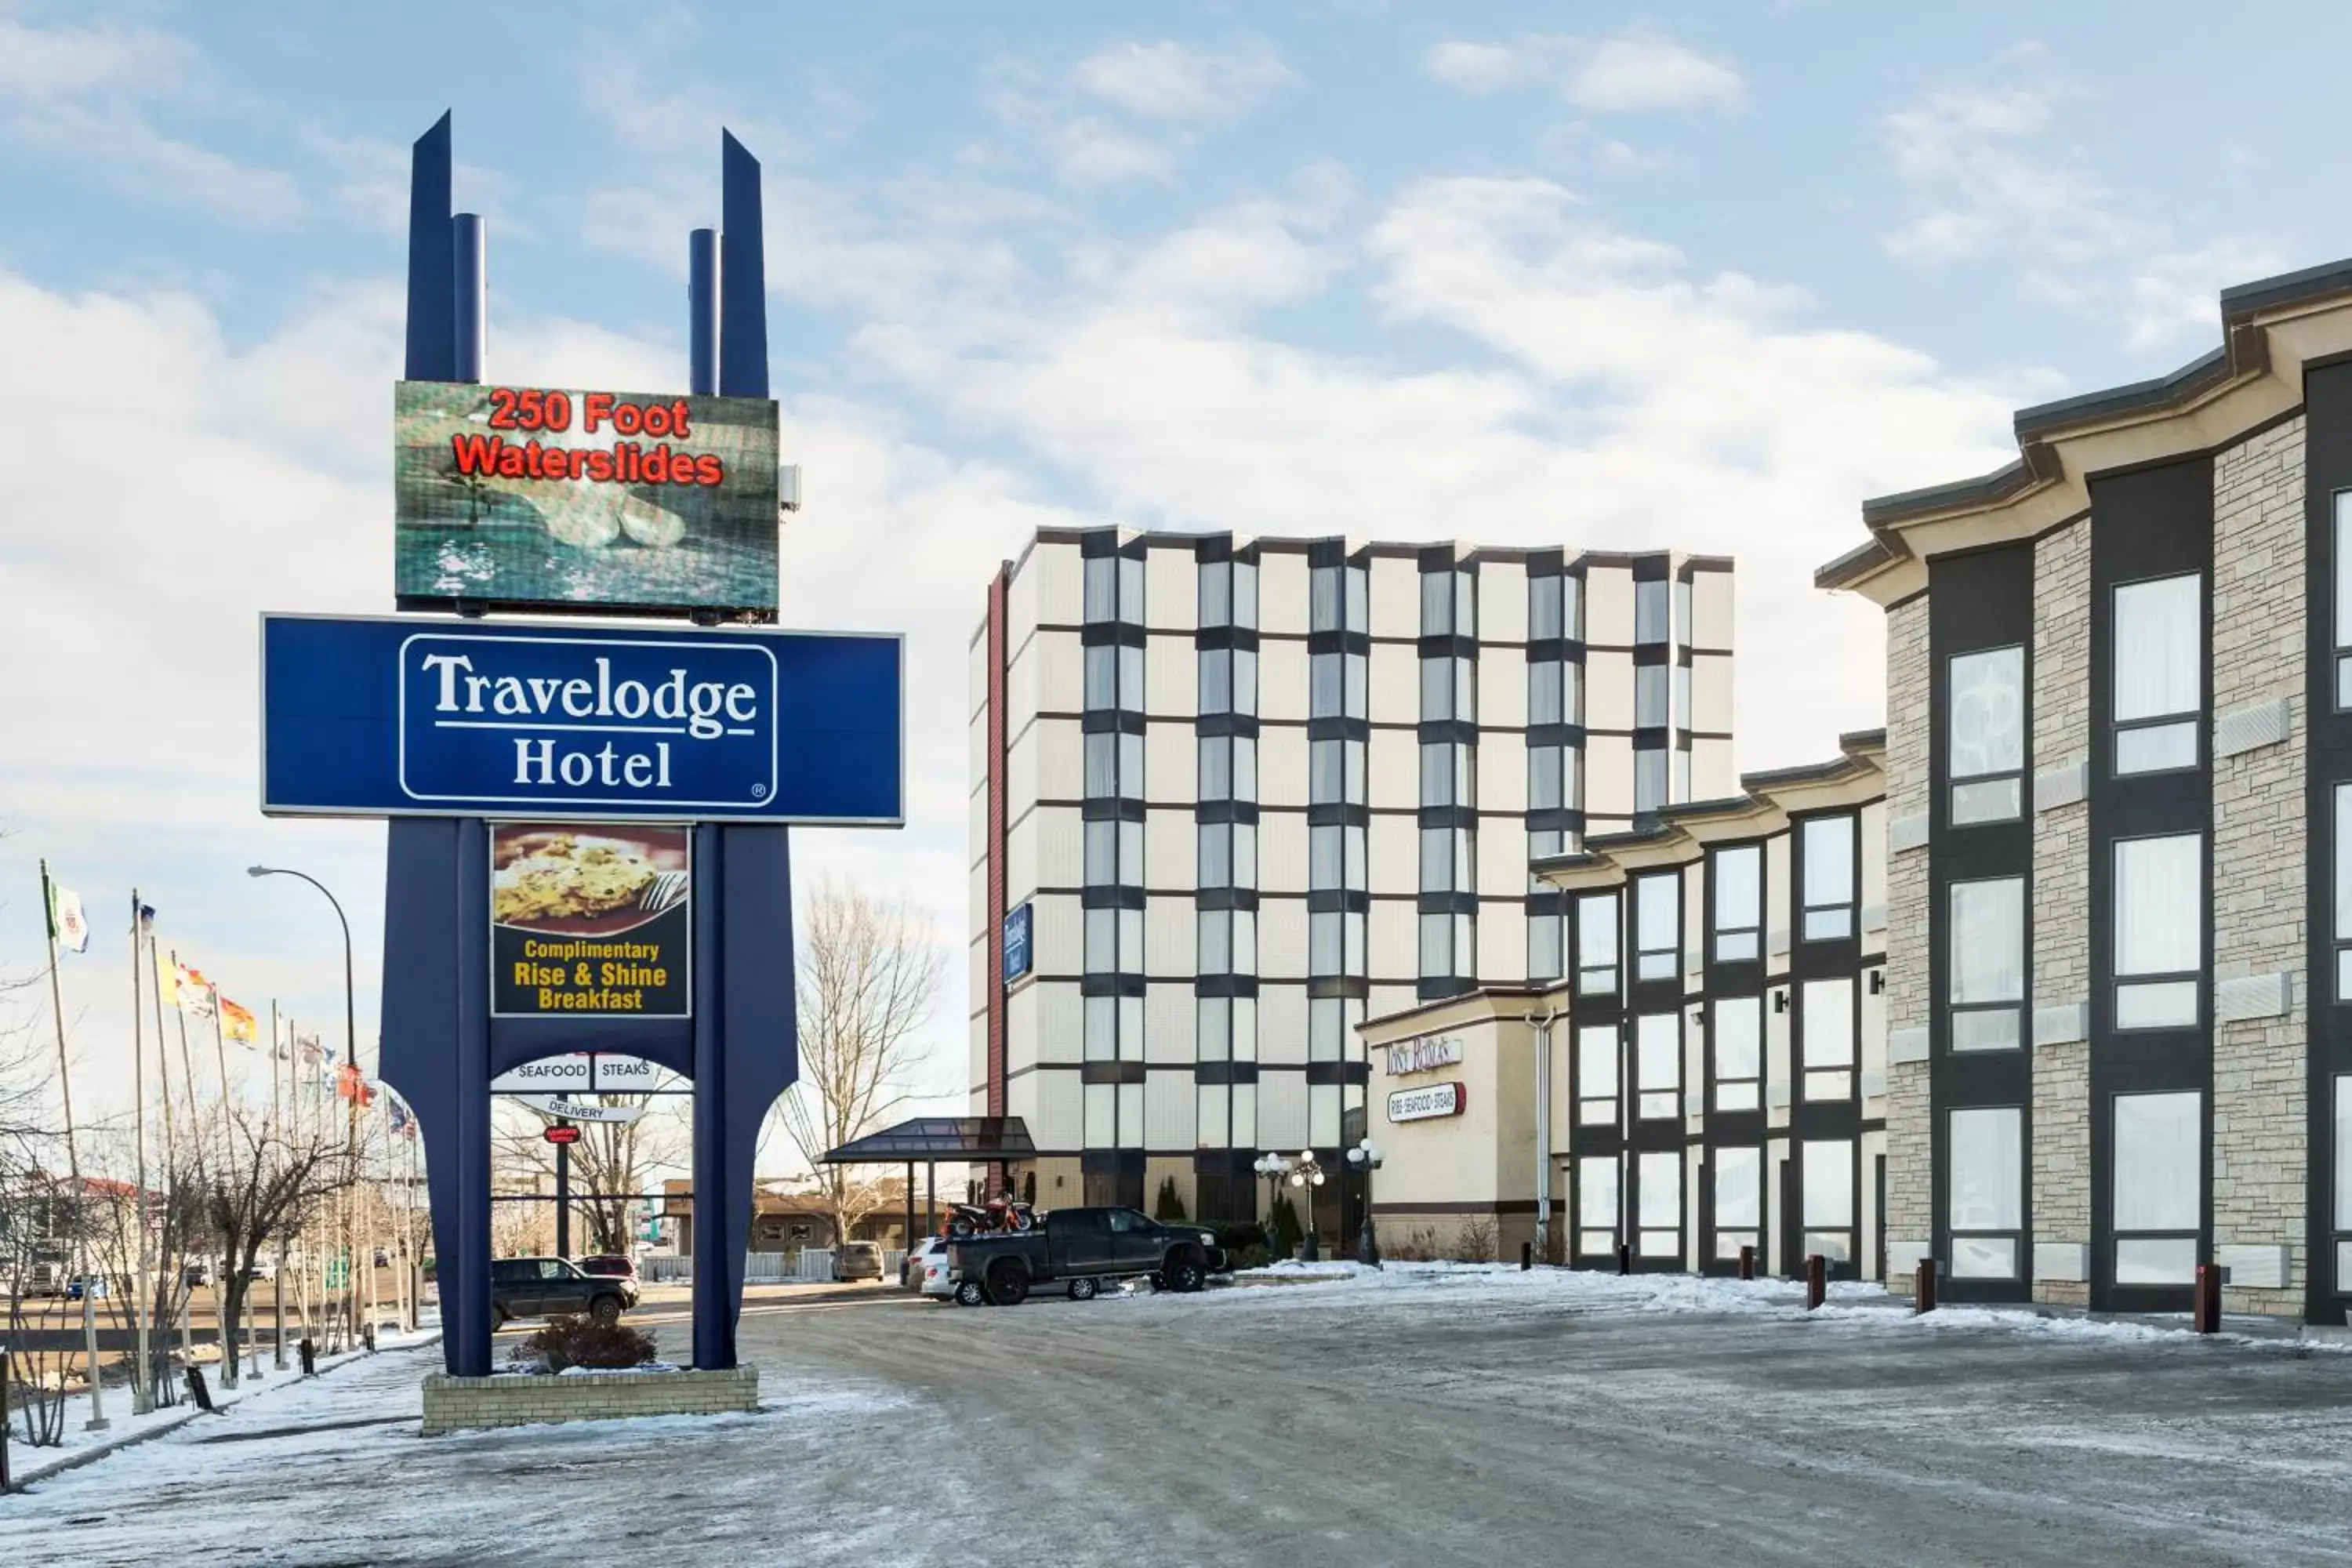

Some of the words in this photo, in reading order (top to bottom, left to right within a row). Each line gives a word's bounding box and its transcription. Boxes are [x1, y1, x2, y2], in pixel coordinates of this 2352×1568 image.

[489, 388, 572, 432] 250
[584, 392, 691, 439] Foot
[452, 433, 724, 486] Waterslides
[422, 654, 757, 739] Travelodge
[514, 739, 671, 787] Hotel
[525, 940, 660, 961] Complimentary
[514, 962, 565, 986] Rise
[574, 962, 592, 986] &
[601, 962, 667, 987] Shine
[539, 988, 642, 1010] Breakfast
[519, 1065, 586, 1077] SEAFOOD
[602, 1063, 650, 1076] STEAKS
[549, 1101, 604, 1118] DELIVERY
